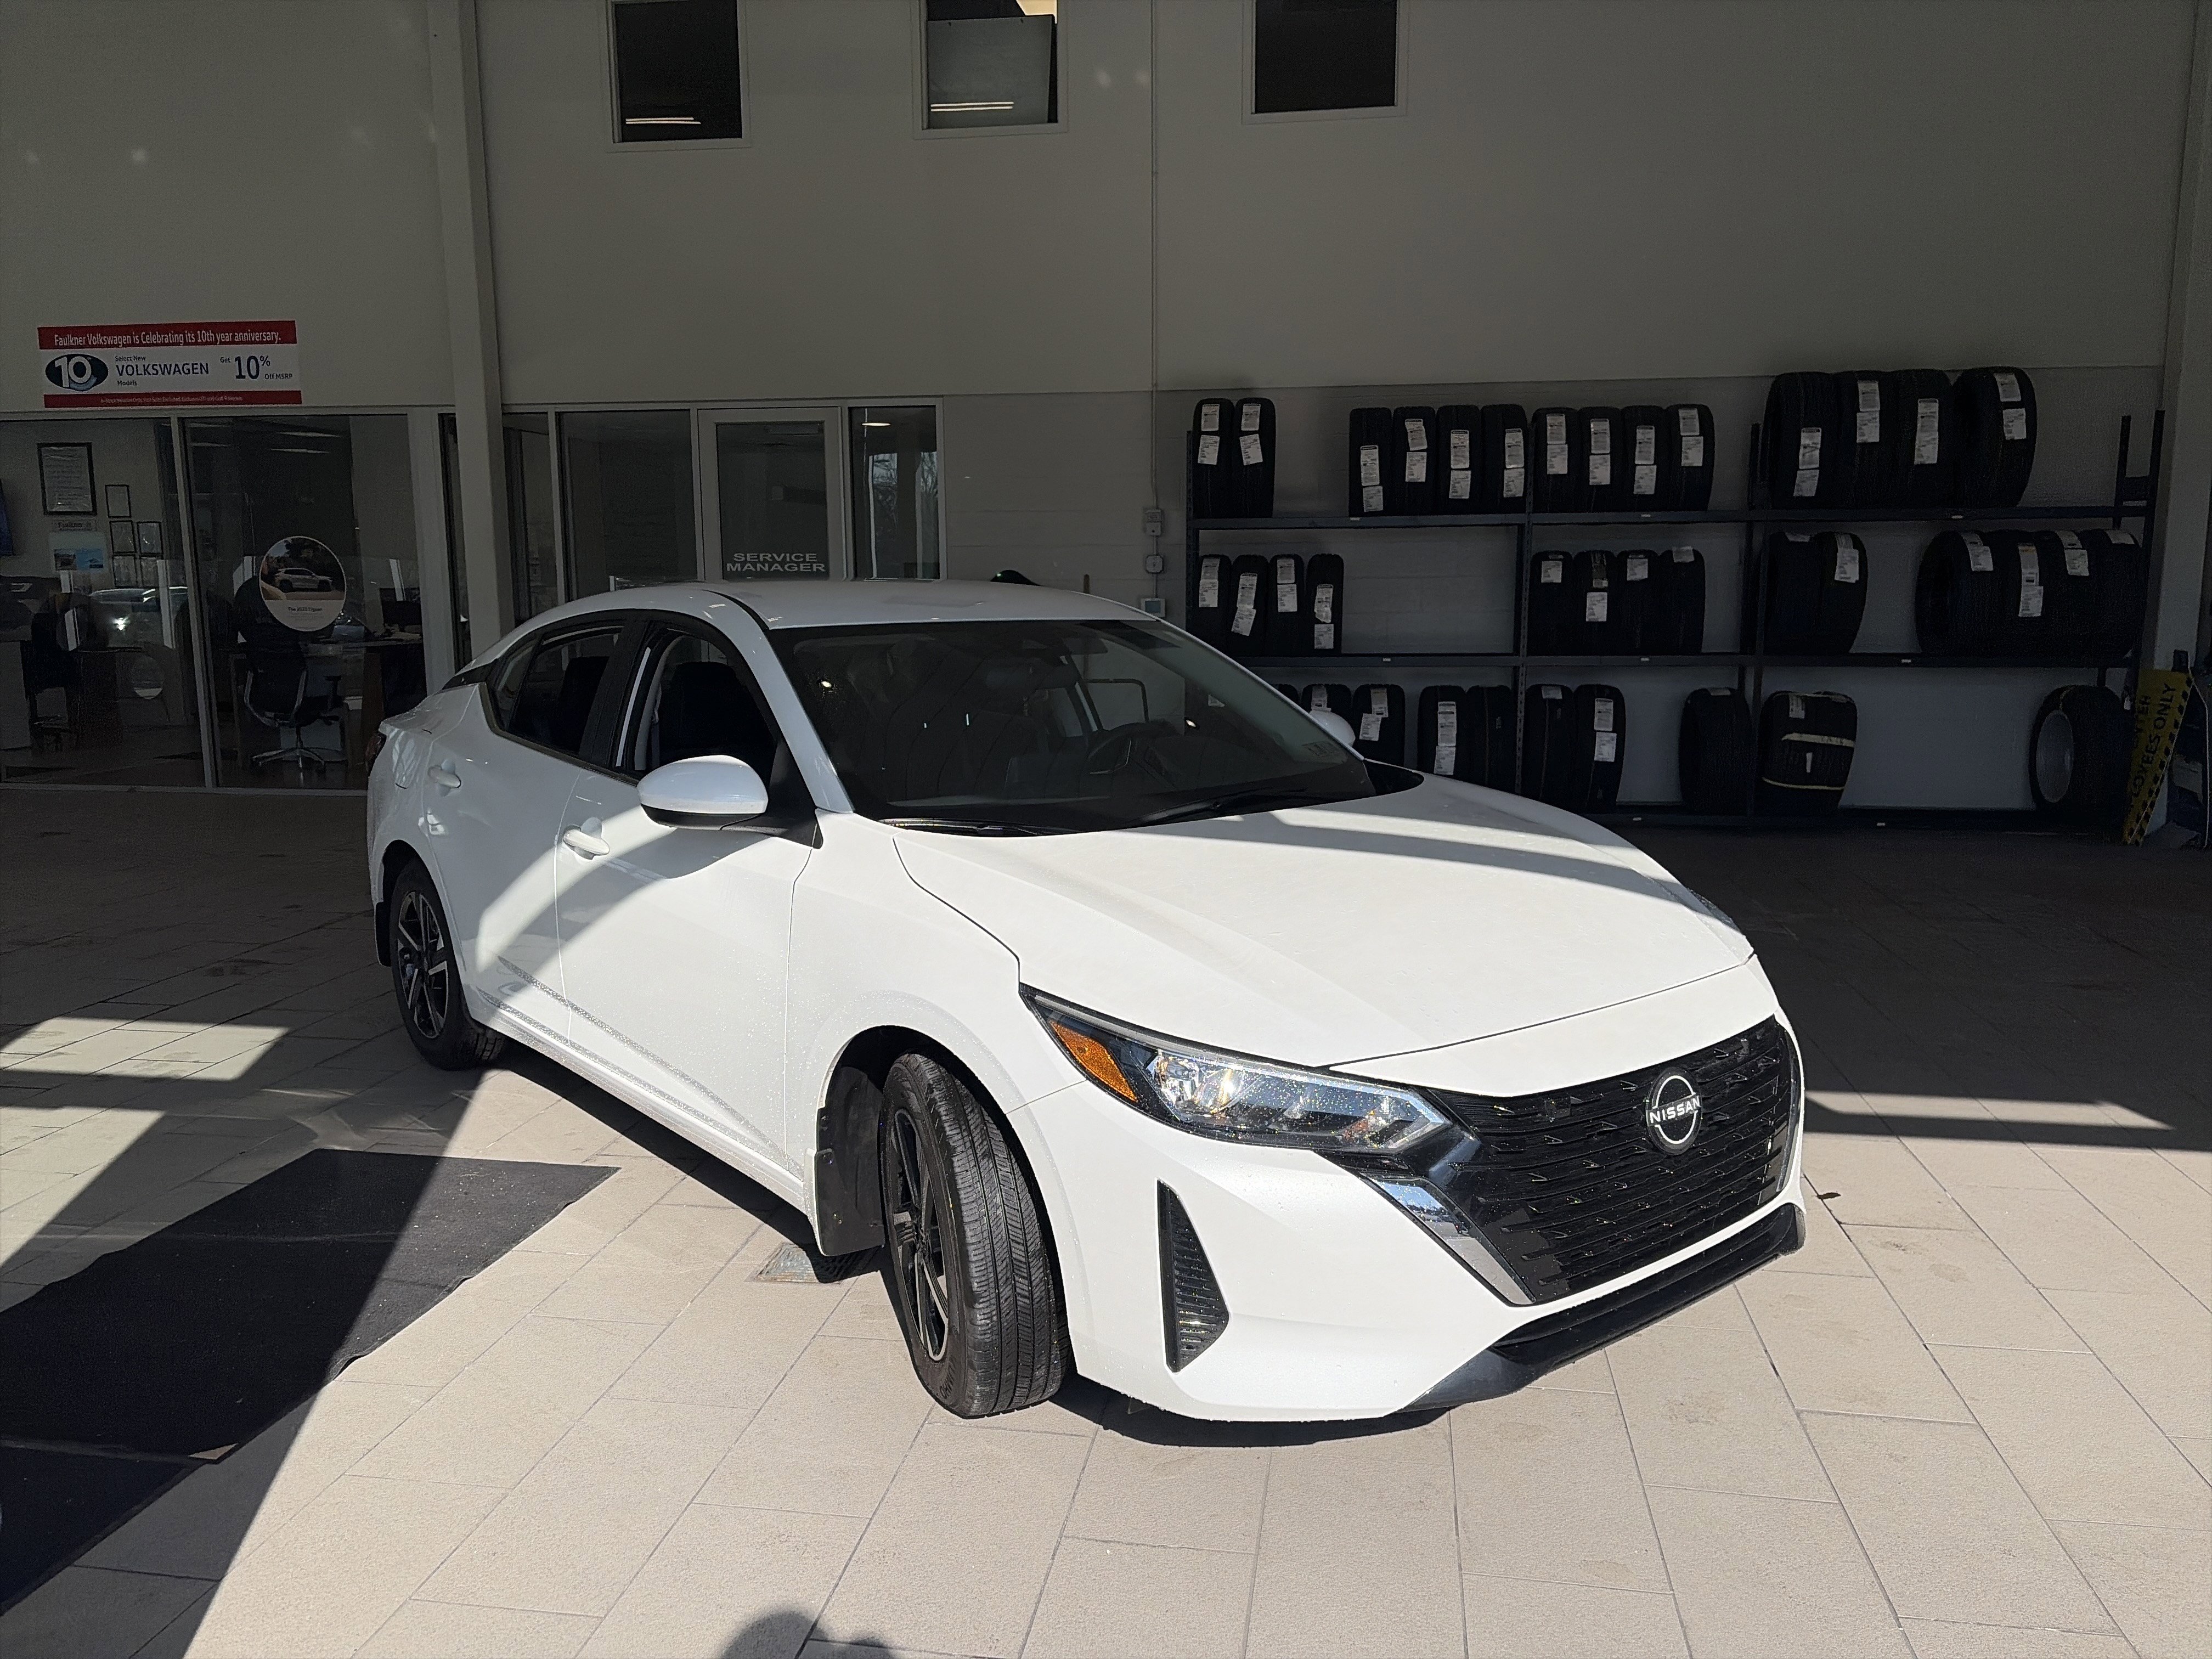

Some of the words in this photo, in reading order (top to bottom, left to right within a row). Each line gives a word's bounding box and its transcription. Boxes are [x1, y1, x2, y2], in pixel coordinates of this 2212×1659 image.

[55, 334, 86, 346] Faulkner
[87, 332, 131, 347] Volkswagen
[133, 331, 139, 344] is
[140, 331, 184, 346] Celebrating
[185, 330, 195, 343] its
[197, 330, 215, 342] 10th
[216, 331, 233, 345] year
[234, 330, 281, 344] anniversary.
[115, 362, 209, 376] VOLKSWAGEN
[733, 552, 817, 562] SERVICE
[726, 563, 826, 572] MANAGER
[2153, 682, 2176, 730] ONLY
[1649, 1095, 1701, 1124] NISSAN
